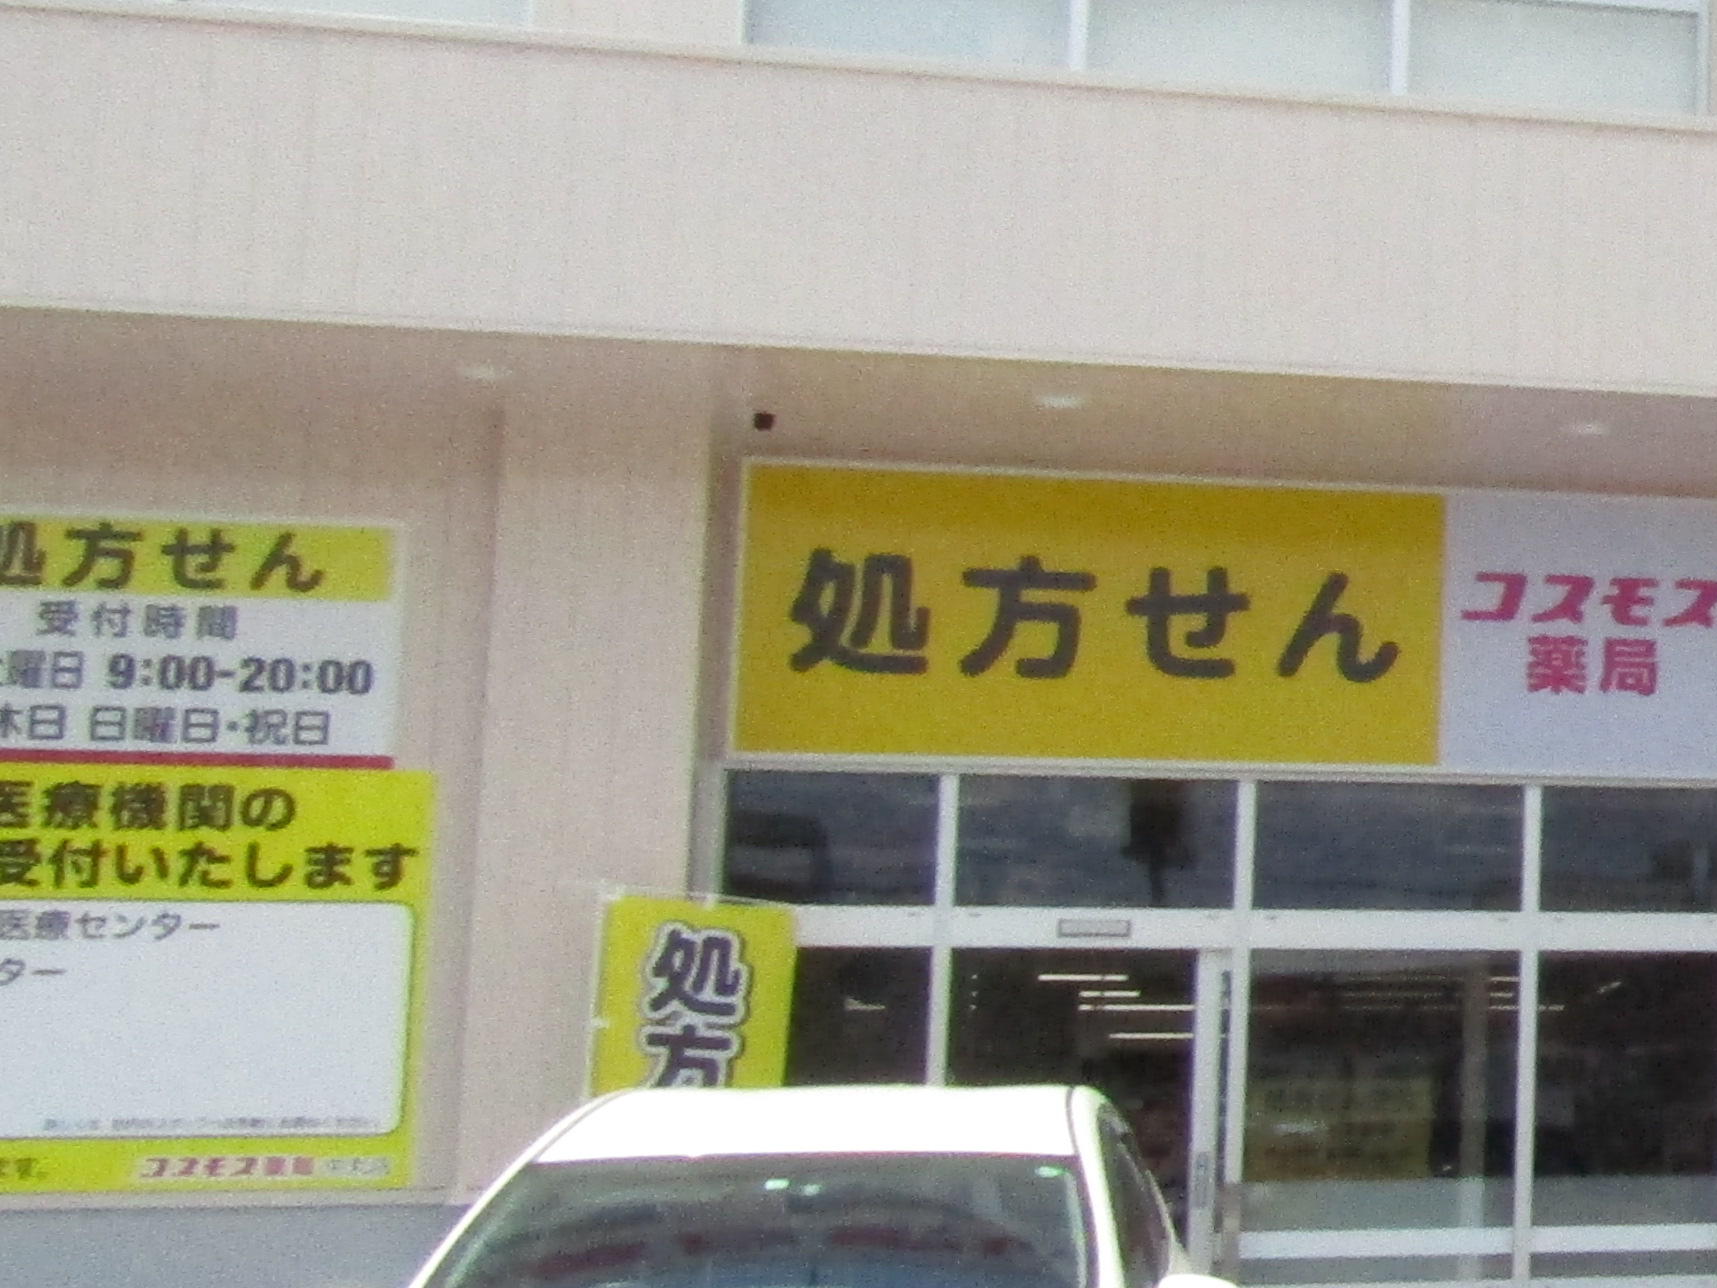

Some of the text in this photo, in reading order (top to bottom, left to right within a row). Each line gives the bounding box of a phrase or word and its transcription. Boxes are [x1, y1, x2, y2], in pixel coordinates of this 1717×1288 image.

[36, 600, 238, 640] 受付時間
[788, 546, 1400, 685] 処方せん
[0, 649, 374, 695] 曜日 9:00-20:00
[1527, 634, 1658, 695] 薬局
[90, 705, 330, 746] 日曜日・祝日
[0, 837, 420, 891] 受付いたします
[0, 909, 221, 942] 医療センター
